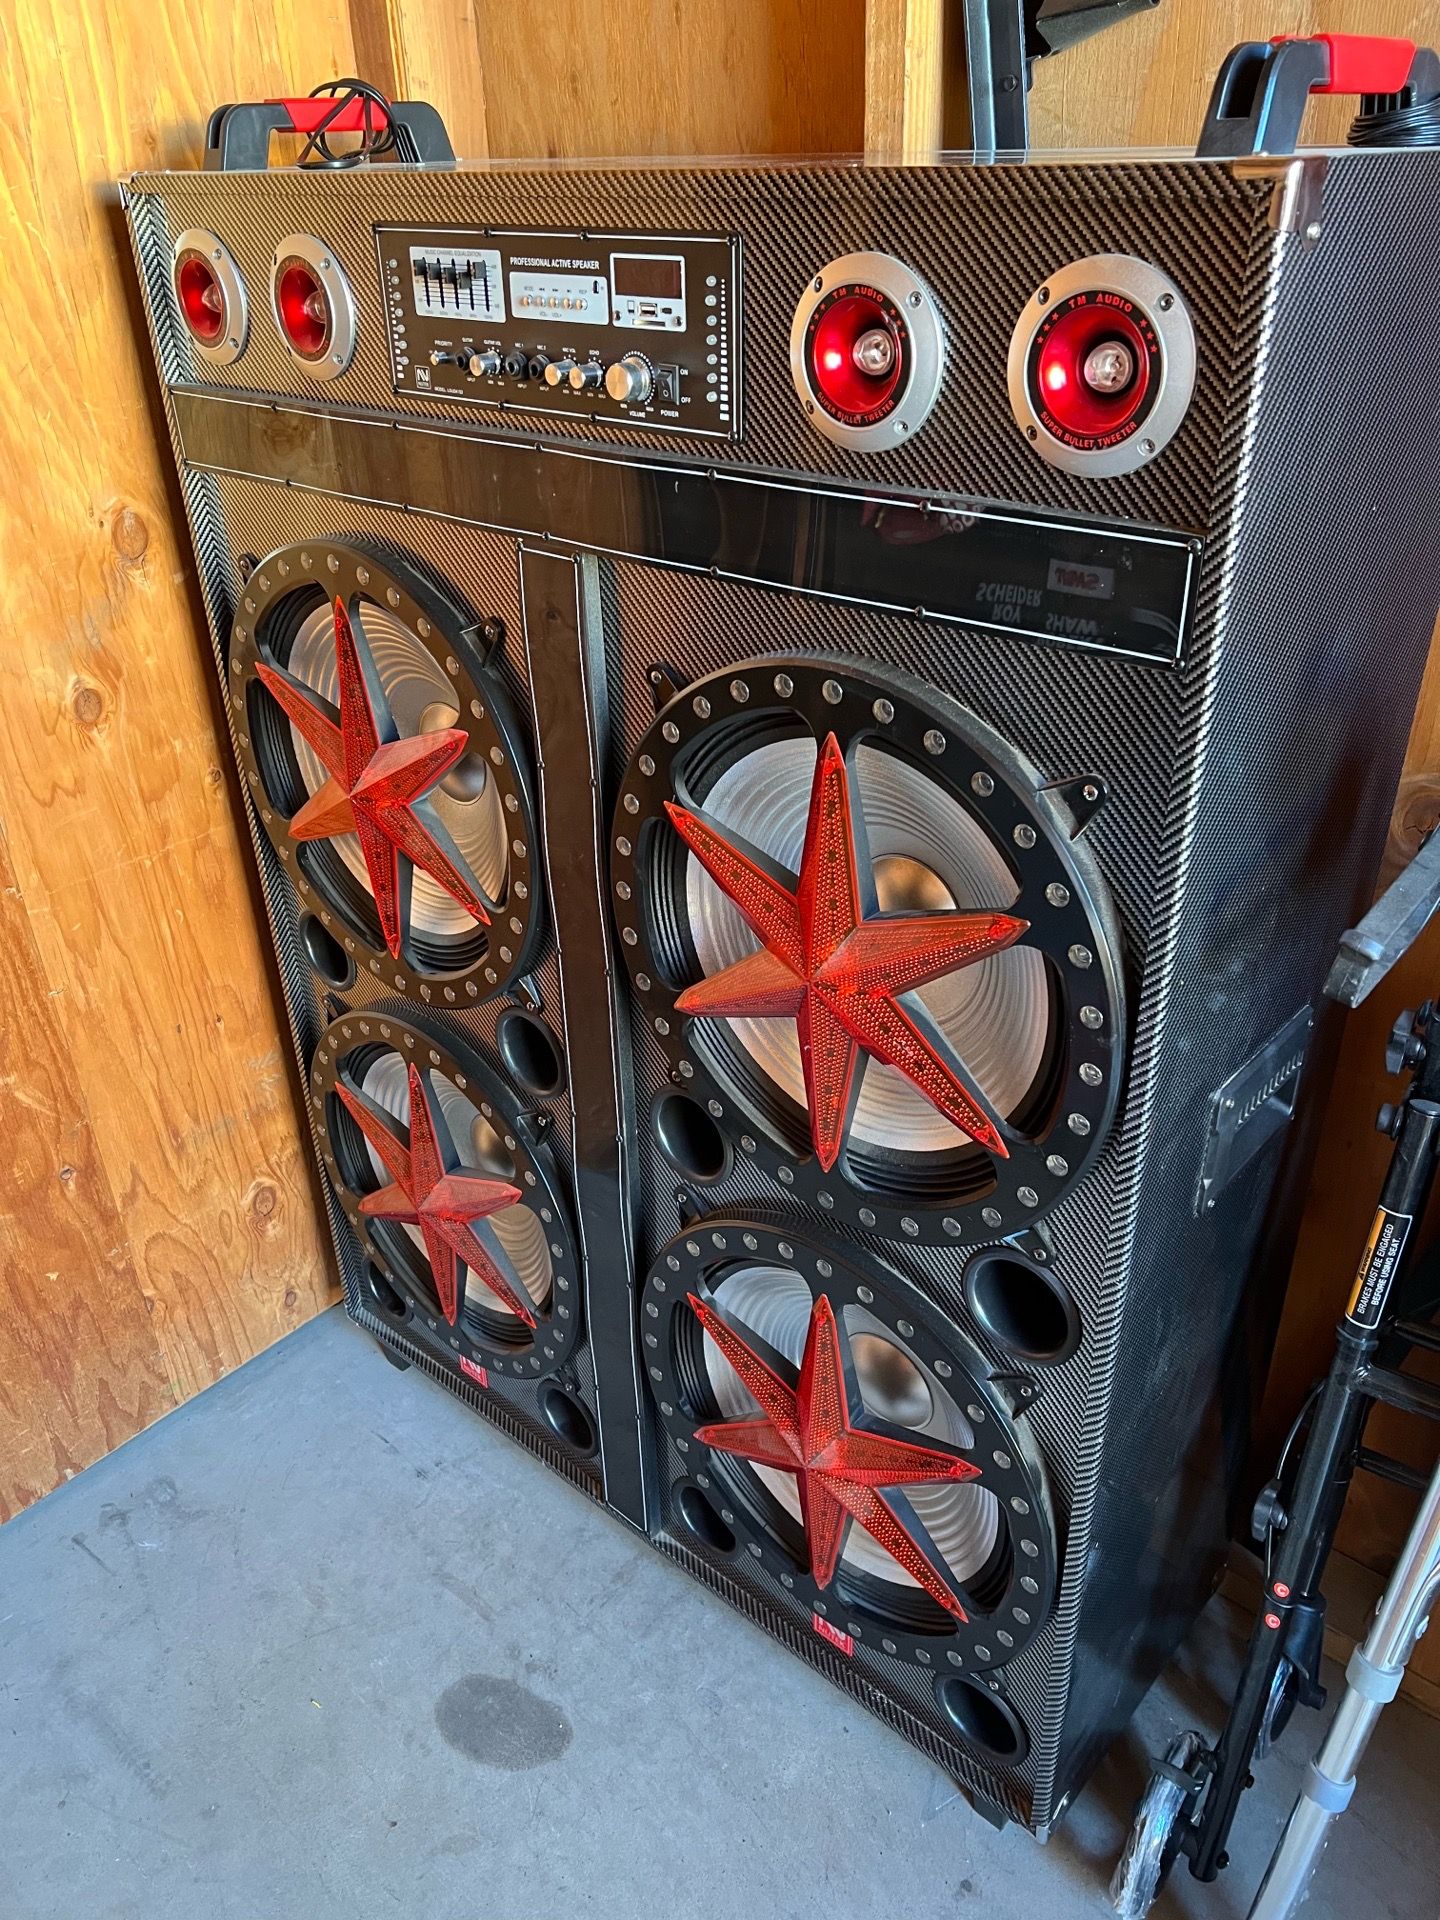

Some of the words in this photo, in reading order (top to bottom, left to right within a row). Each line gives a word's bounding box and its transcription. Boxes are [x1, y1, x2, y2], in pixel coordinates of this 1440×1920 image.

[509, 256, 551, 267] PROFESSIONAL
[551, 259, 572, 269] ACTIVE
[572, 260, 600, 270] SPEAKER
[832, 287, 847, 299] TM
[853, 285, 884, 303] AUDIO
[1068, 295, 1087, 309] TM
[1095, 293, 1133, 313] AUDIO
[680, 368, 689, 376] ON
[680, 396, 691, 404] OFF
[816, 391, 837, 417] SUPER
[837, 410, 862, 424] BULLET
[864, 399, 895, 423] TWEETER
[629, 410, 646, 418] VOLUME
[660, 409, 679, 418] POWER
[1040, 411, 1063, 438] SUPER
[1063, 432, 1095, 448] BULLET
[1097, 421, 1138, 447] TWEETER
[1376, 1223, 1394, 1257] ENGAGED
[1370, 1279, 1387, 1306] BEFORE
[1381, 1258, 1394, 1279] USING
[1388, 1236, 1402, 1258] SEAT.
[1373, 1256, 1383, 1267] BE
[1366, 1268, 1379, 1288] MUST
[1356, 1286, 1372, 1314] BRAKES
